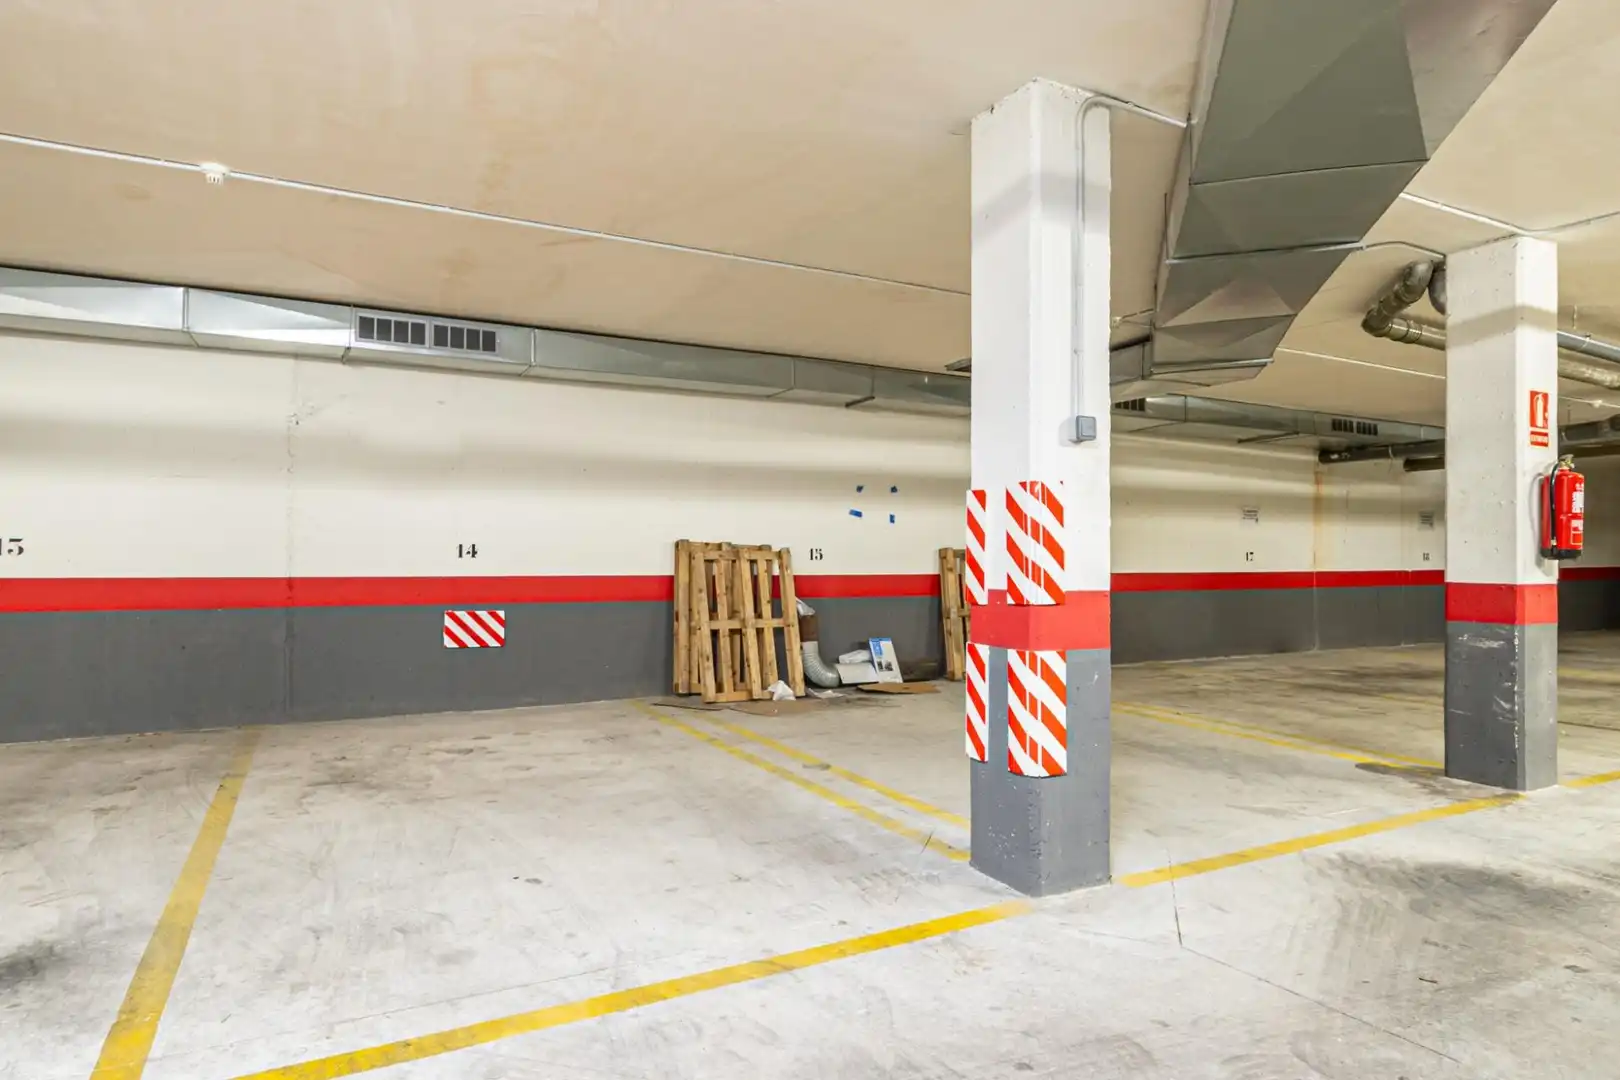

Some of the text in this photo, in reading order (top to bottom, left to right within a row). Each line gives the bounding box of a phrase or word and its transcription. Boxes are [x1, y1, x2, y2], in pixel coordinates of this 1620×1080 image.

[456, 543, 478, 559] 14
[809, 547, 824, 561] 15
[1245, 551, 1255, 562] 17
